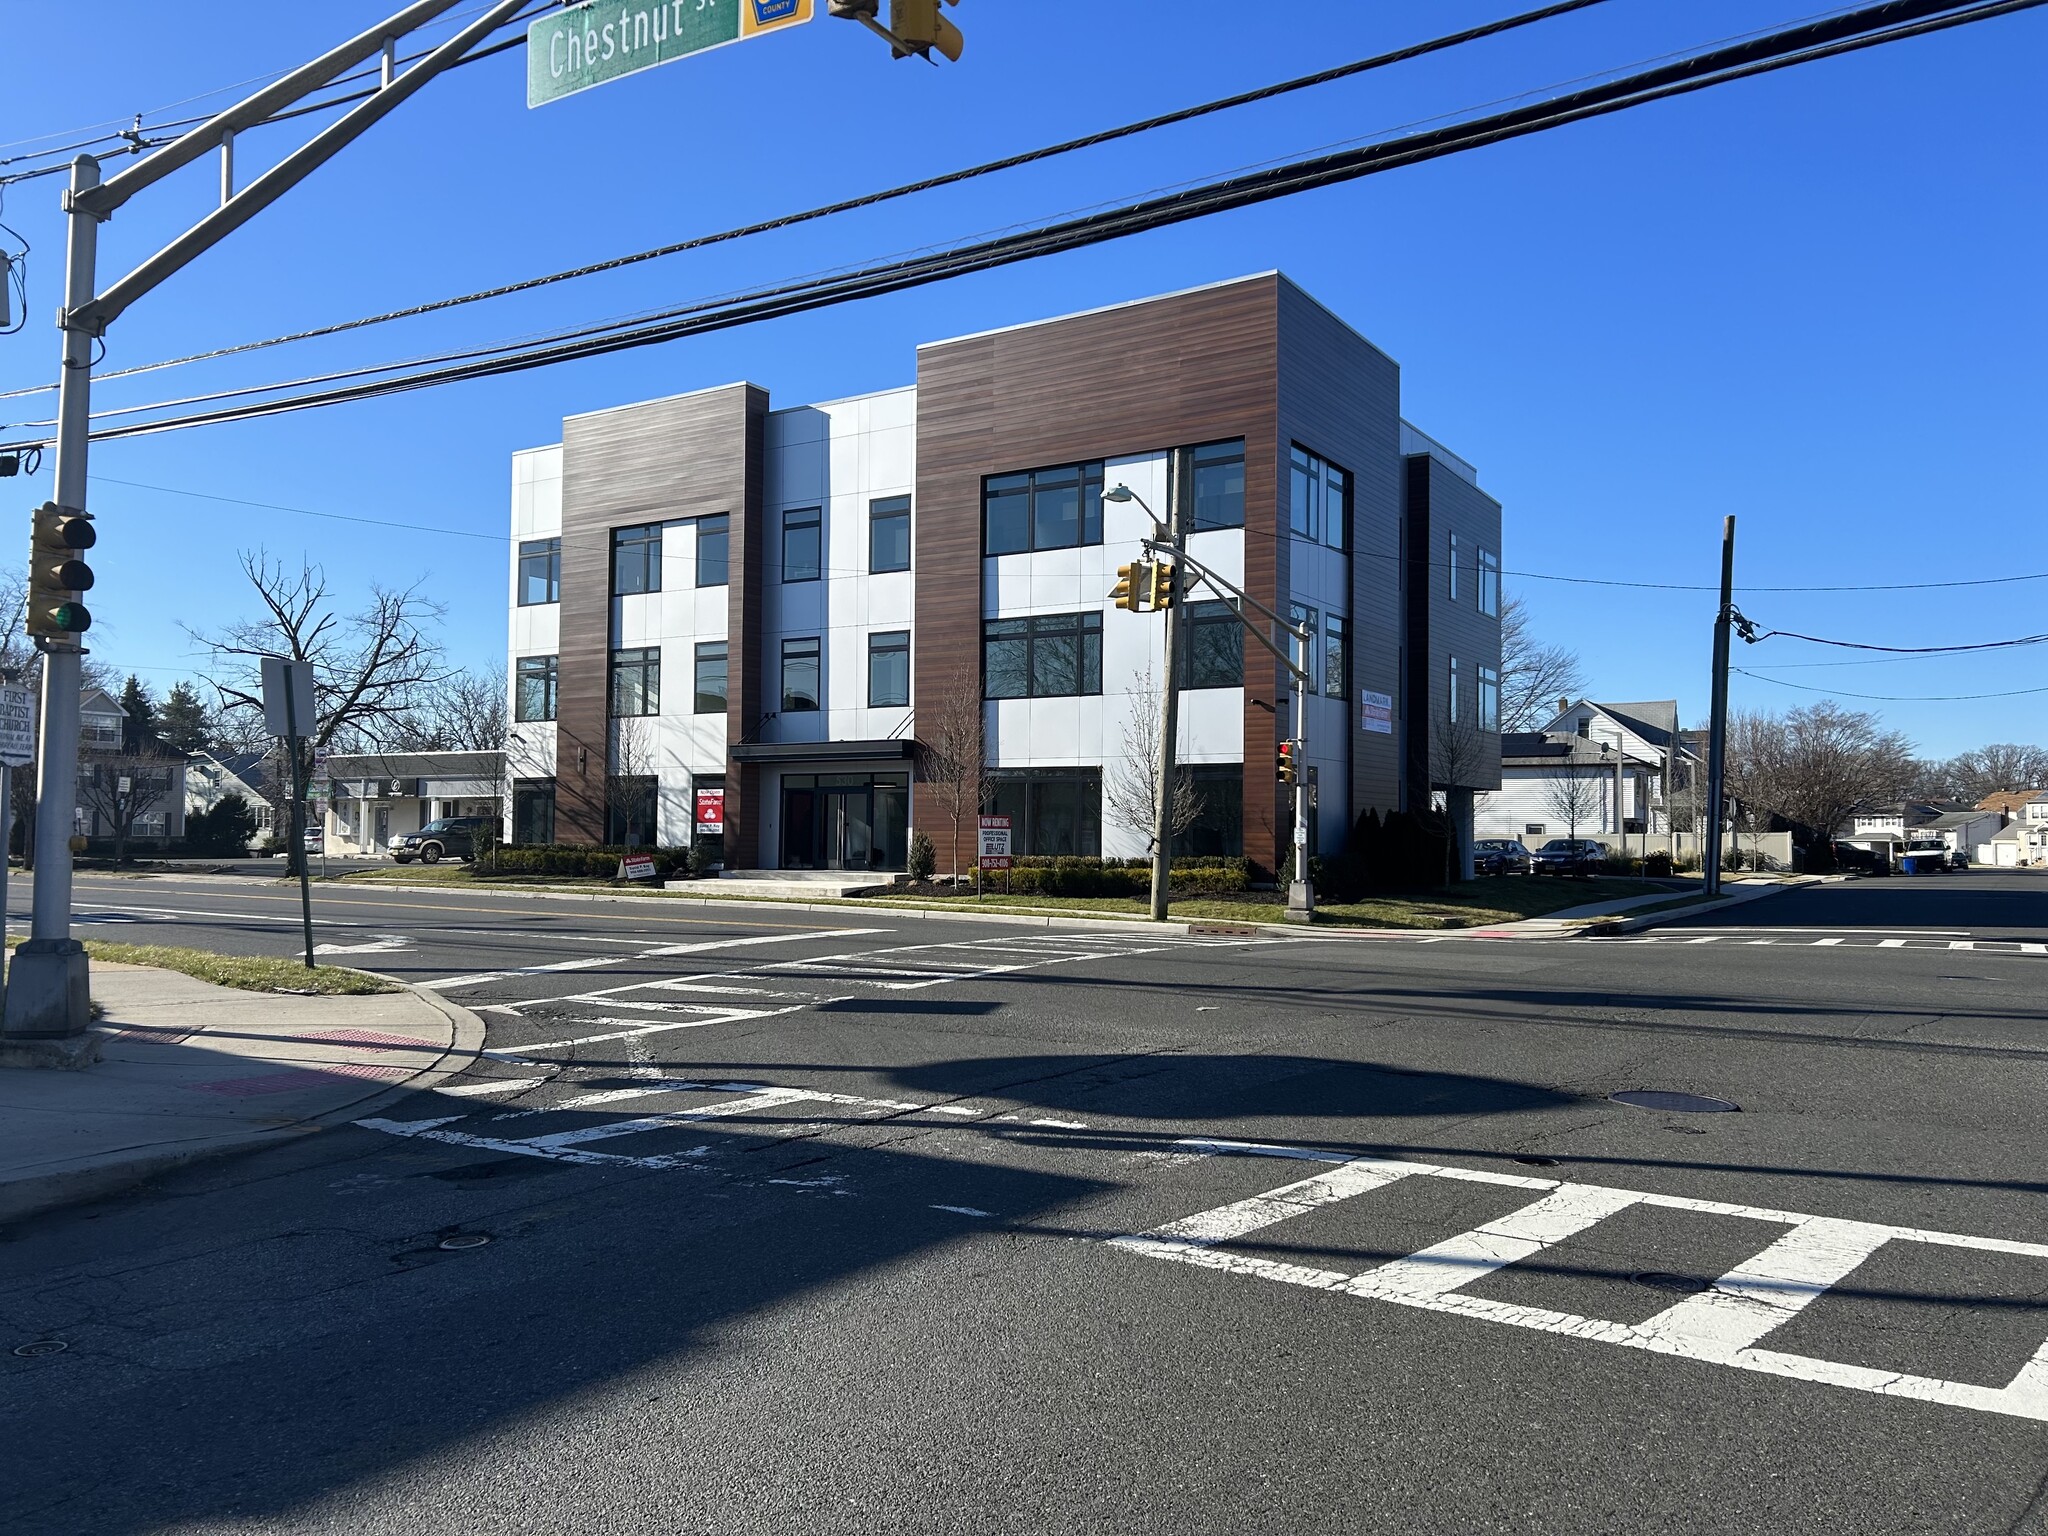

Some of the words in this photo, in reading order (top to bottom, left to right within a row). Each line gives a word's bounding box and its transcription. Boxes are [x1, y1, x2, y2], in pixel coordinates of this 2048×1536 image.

[762, 1, 790, 14] COUNTY
[550, 0, 684, 79] Chestnut
[3, 690, 27, 705] FIRST
[836, 776, 854, 786] 530
[981, 817, 991, 827] NOW
[992, 817, 1009, 827] RENTING
